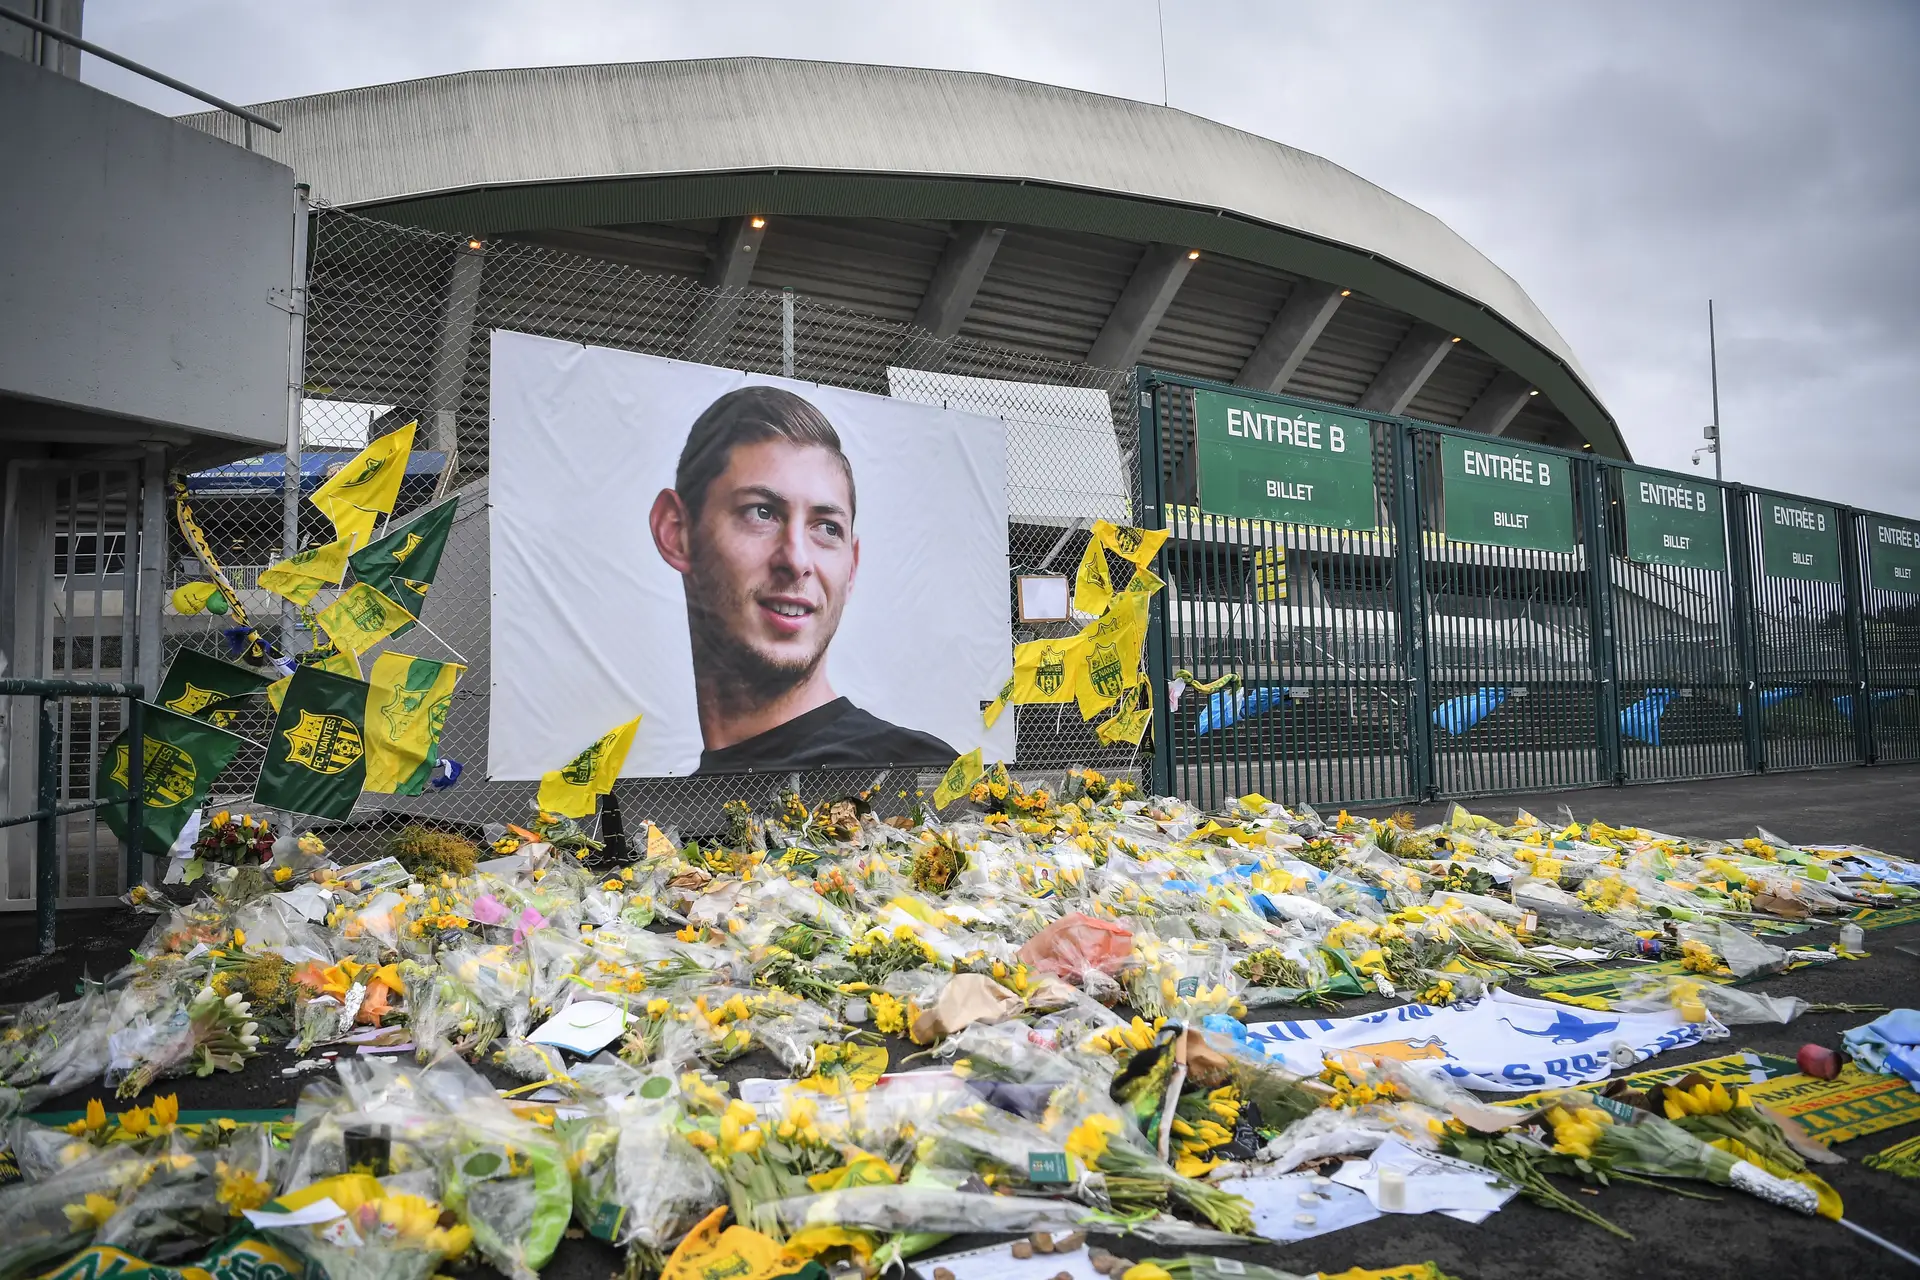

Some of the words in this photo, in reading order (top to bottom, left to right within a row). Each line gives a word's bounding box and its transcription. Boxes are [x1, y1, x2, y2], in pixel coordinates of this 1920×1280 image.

[1227, 408, 1321, 450] ENTRÉE
[1330, 425, 1345, 452] B
[1464, 450, 1534, 484] ENTRÉE
[1538, 463, 1551, 486] B
[1266, 480, 1314, 501] BILLET
[1640, 481, 1693, 510] ENTRÉE
[1696, 491, 1706, 512] B
[1493, 511, 1529, 529] BILLET
[1773, 505, 1815, 531] ENTRÉE
[1817, 514, 1825, 532] B
[1663, 534, 1690, 550] BILLET
[1878, 525, 1912, 548] ENTRÉE
[1792, 552, 1814, 566] BILLET
[1894, 566, 1911, 579] BILLET
[317, 718, 336, 755] NANTES
[144, 747, 174, 784] NANTES
[313, 756, 324, 769] FC
[1802, 1090, 1920, 1132] ANTES
